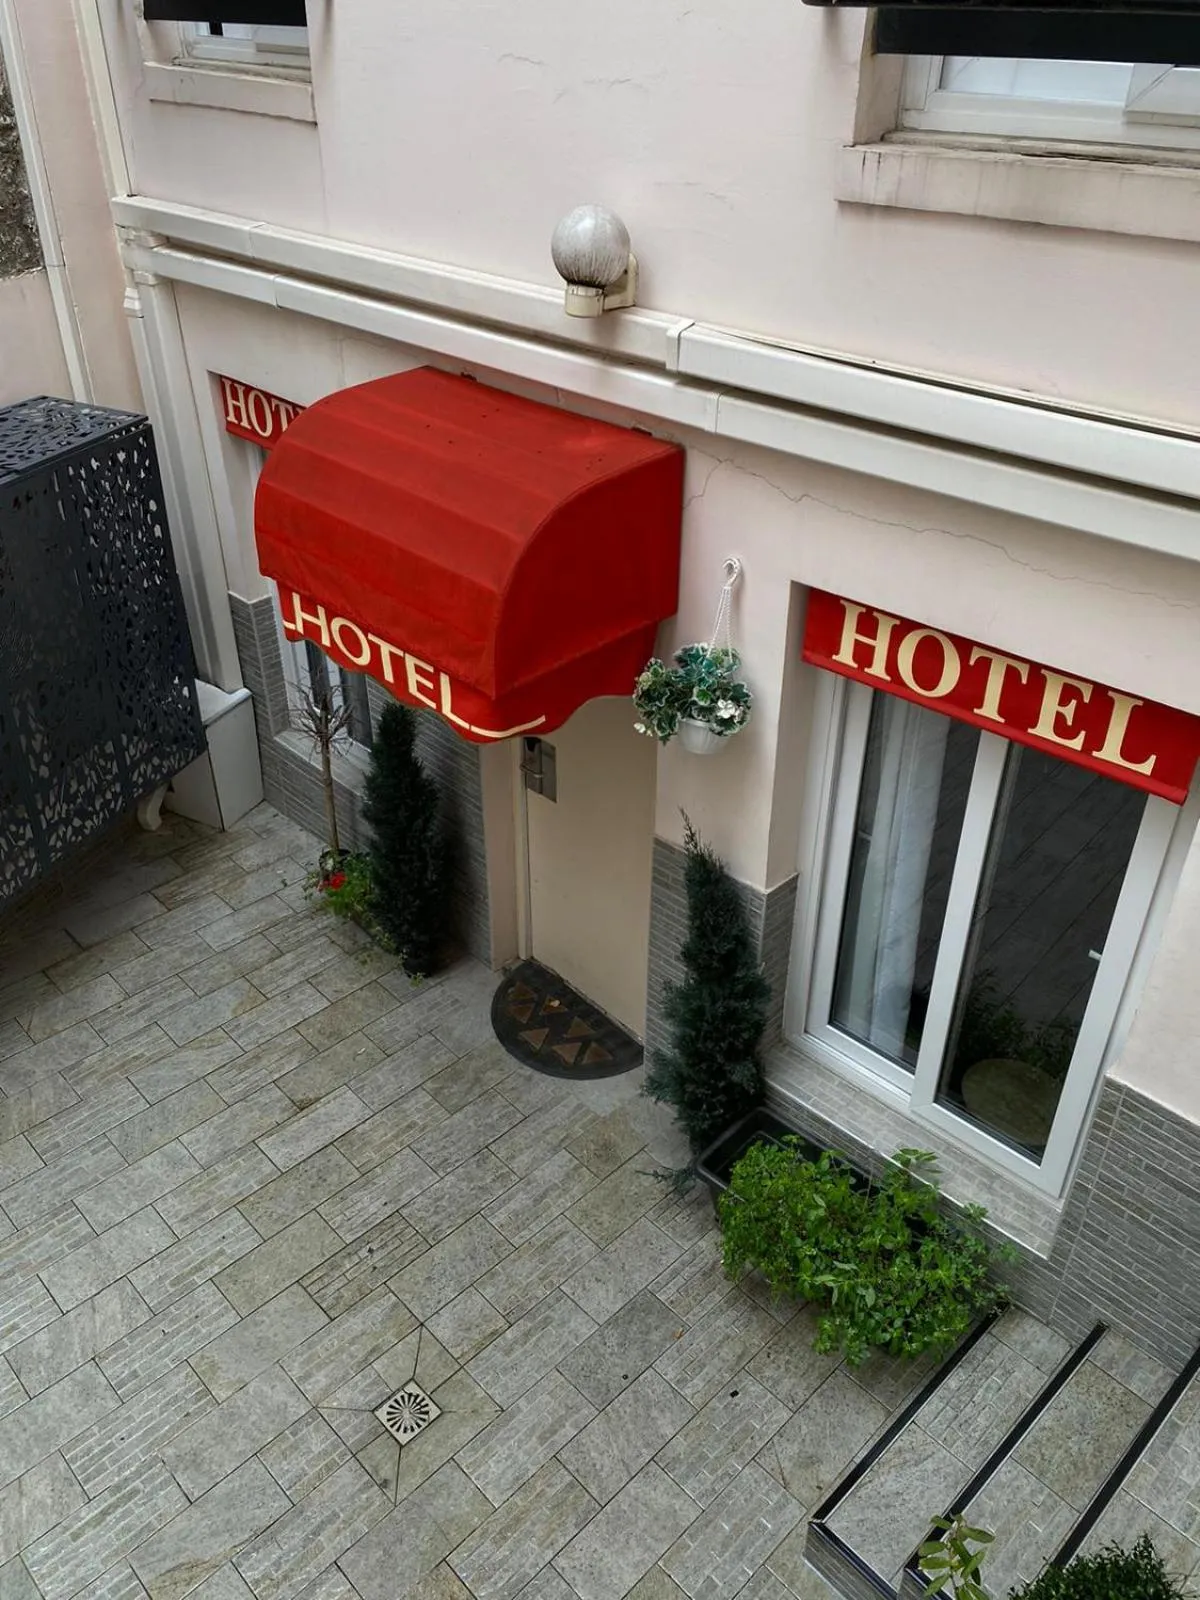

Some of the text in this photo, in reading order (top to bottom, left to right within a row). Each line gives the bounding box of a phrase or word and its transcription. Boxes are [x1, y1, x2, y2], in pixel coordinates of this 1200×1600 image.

[222, 378, 304, 437] HOT
[291, 591, 471, 729] HOTEL
[832, 599, 1157, 776] HOTEL
